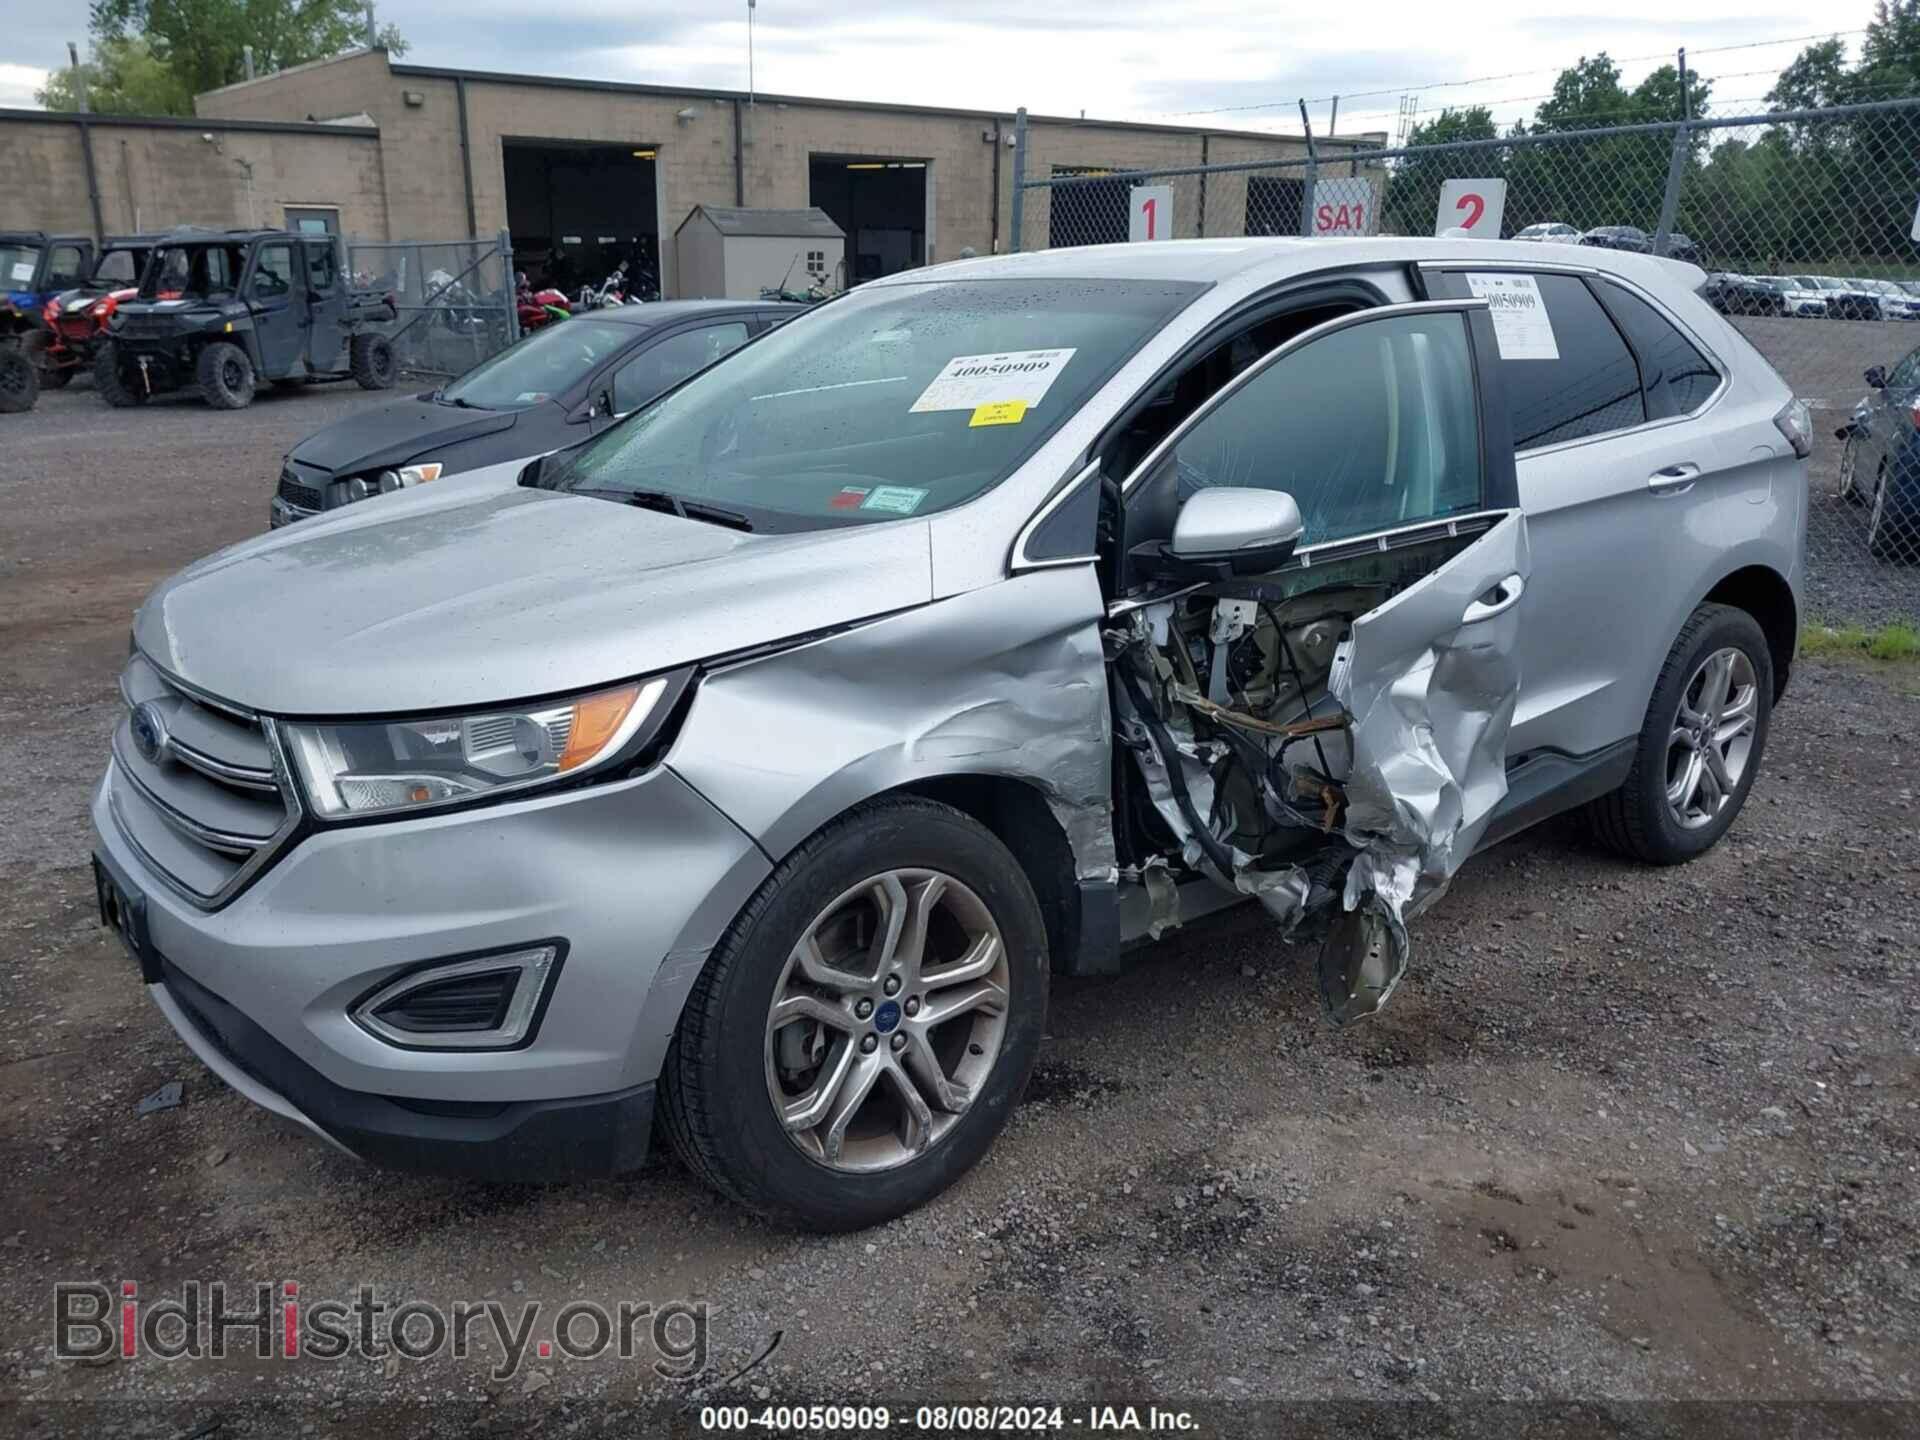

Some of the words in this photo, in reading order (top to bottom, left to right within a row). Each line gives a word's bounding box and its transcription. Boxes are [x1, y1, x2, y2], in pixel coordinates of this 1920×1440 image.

[1142, 198, 1157, 240] 1
[1316, 203, 1363, 232] SA1
[1456, 193, 1485, 229] 2
[952, 361, 1050, 377] 40050909
